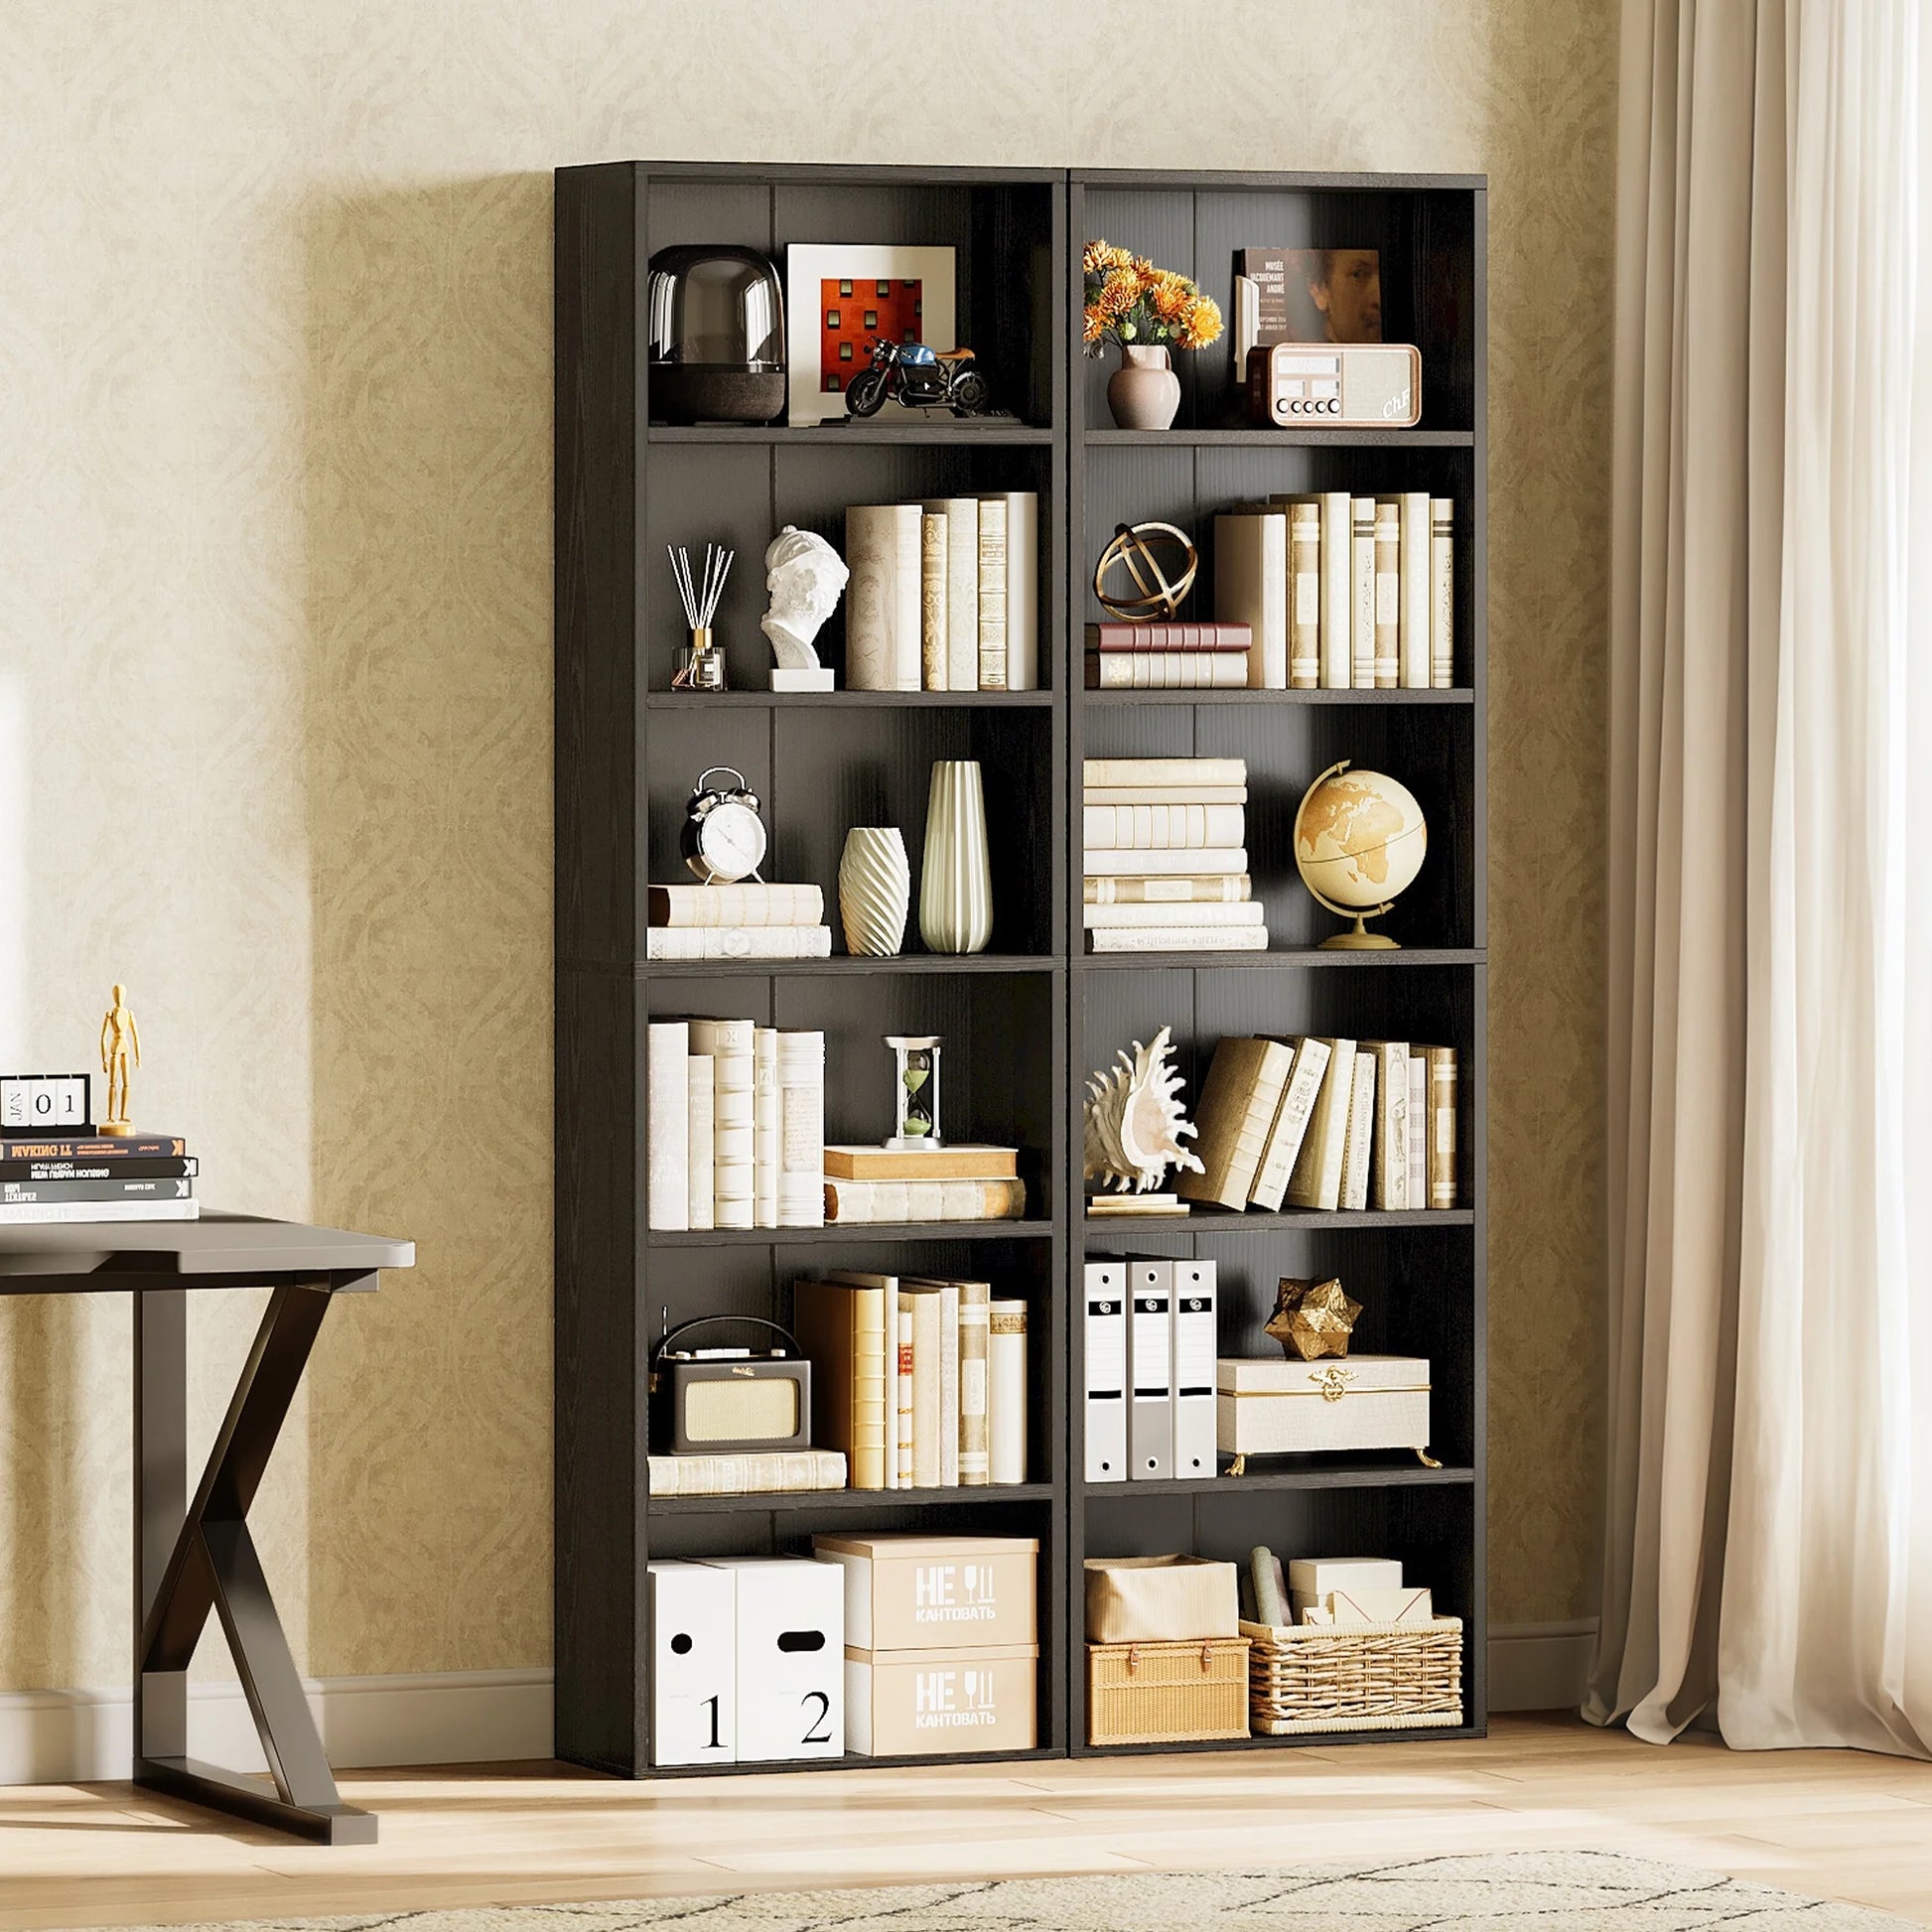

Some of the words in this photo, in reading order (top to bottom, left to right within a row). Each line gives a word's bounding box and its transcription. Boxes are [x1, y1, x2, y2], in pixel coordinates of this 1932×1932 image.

[915, 1565, 956, 1606] НЕ
[915, 1605, 996, 1622] КАНТОВАТЬ
[915, 1670, 956, 1712] НЕ
[700, 1694, 729, 1749] 1
[800, 1691, 833, 1744] 2
[915, 1711, 996, 1728] КАНТОВАТЬ
